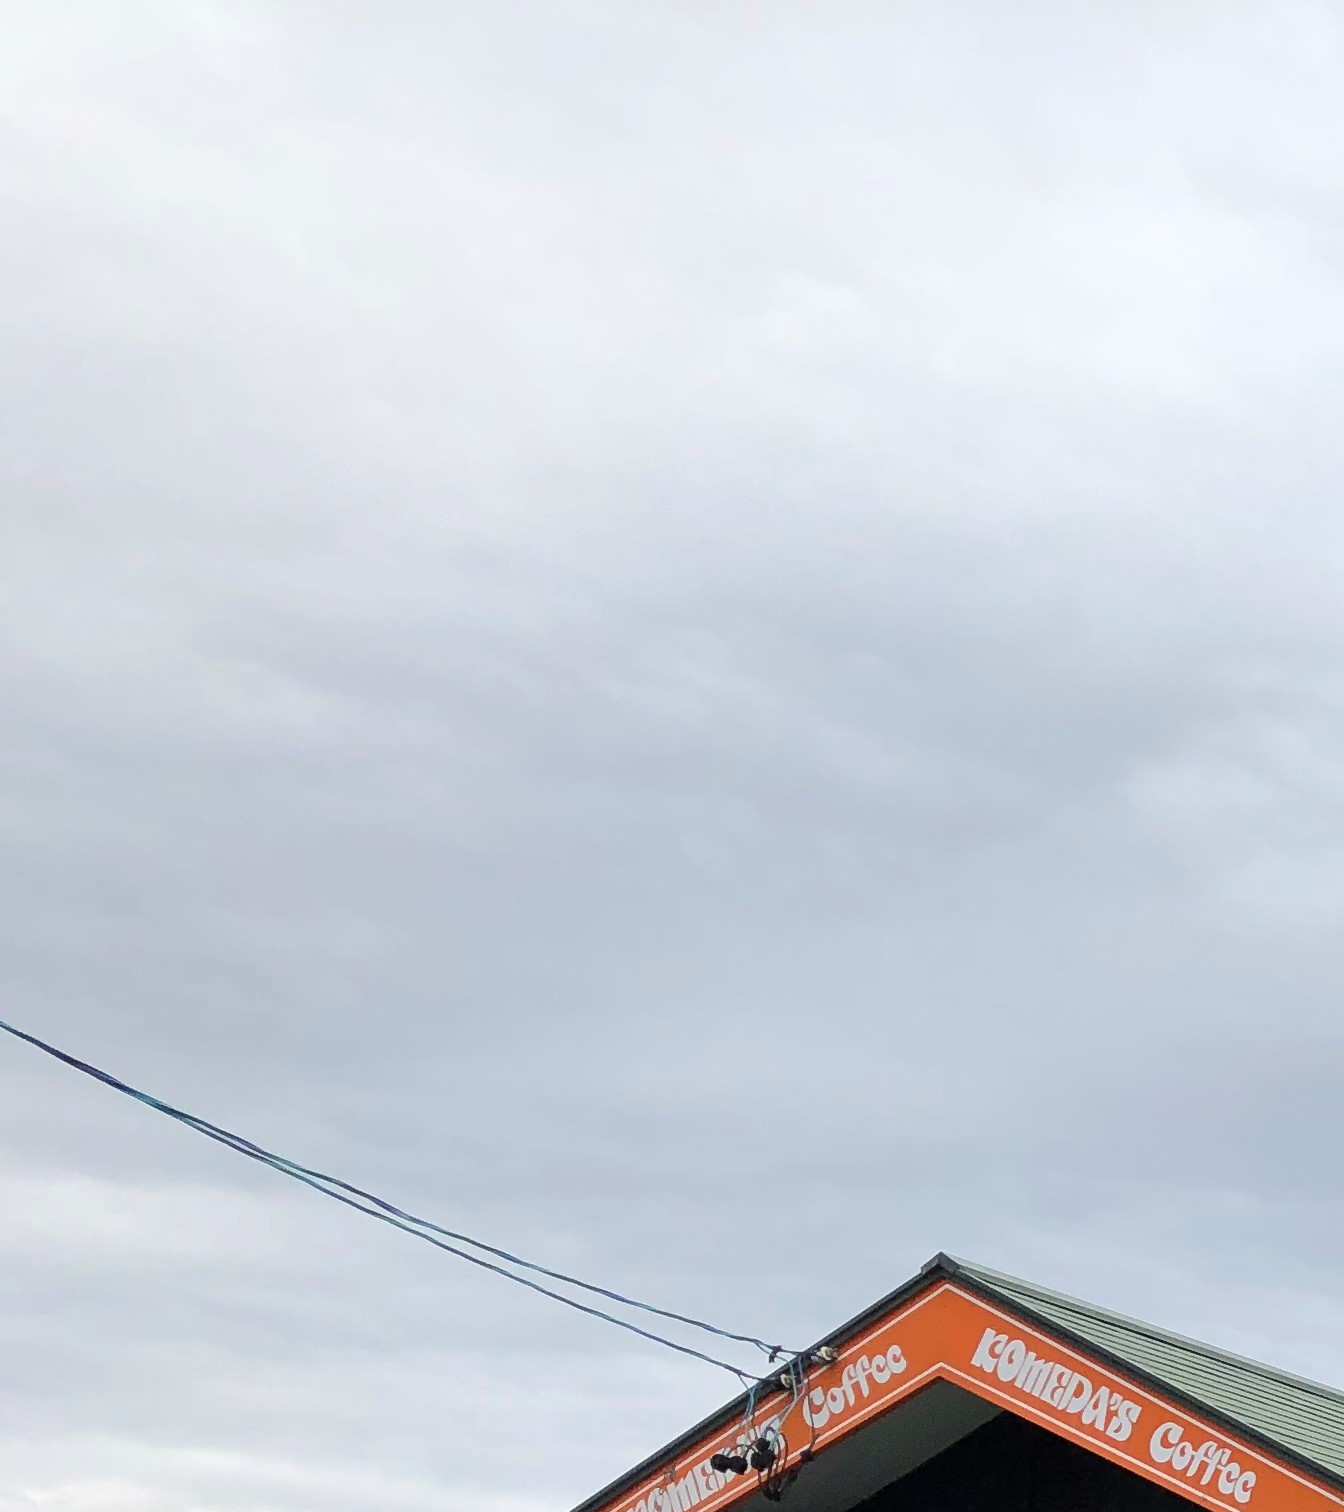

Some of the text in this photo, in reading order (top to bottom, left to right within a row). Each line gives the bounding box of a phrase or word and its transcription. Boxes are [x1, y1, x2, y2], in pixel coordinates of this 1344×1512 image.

[802, 1344, 908, 1429] Coffee
[970, 1327, 1257, 1504] KOMEDA'S Coffee
